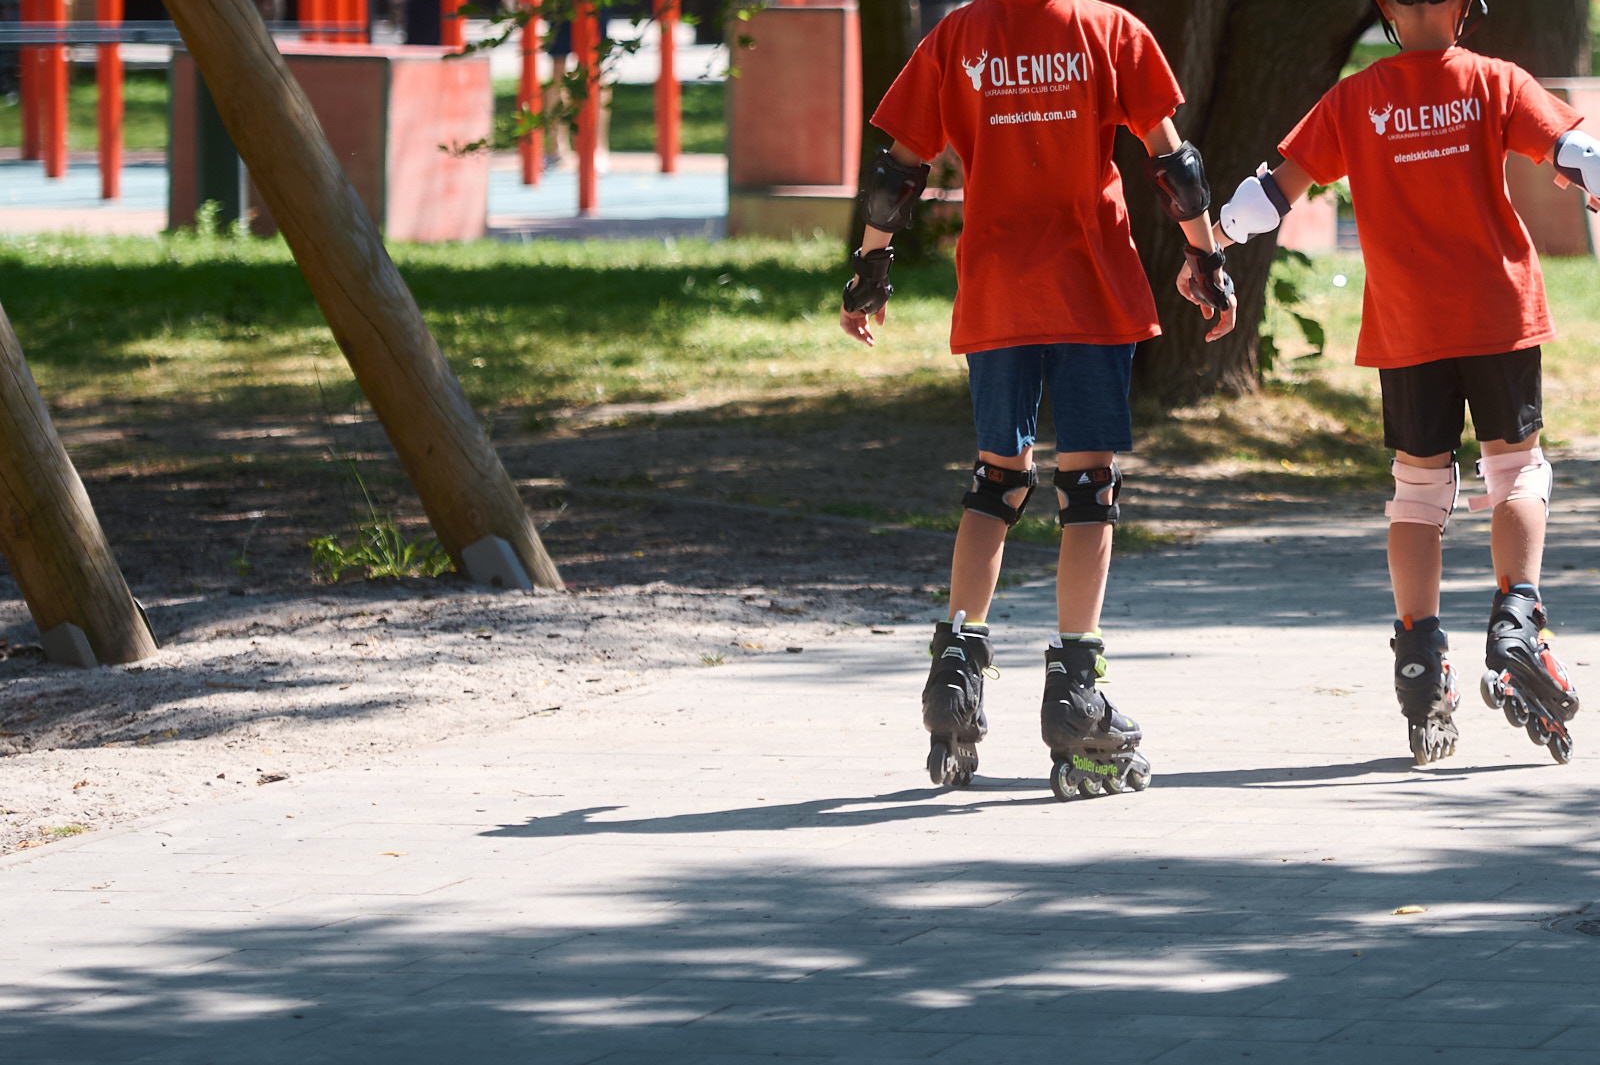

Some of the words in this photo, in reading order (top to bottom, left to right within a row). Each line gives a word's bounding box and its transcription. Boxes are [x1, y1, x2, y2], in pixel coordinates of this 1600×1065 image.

[990, 52, 1088, 86] OLENISKI
[985, 88, 1018, 98] UKRAINIAN
[1018, 87, 1030, 95] SKI
[1030, 85, 1049, 94] CLUB
[1049, 84, 1070, 93] OLENI
[990, 108, 1077, 125] oleniskiclub.com.ua
[1394, 98, 1480, 132] OLENISKI
[1387, 131, 1420, 141] UKRAINIAN
[1431, 128, 1448, 137] CLUB
[1448, 123, 1466, 133] OLENI
[1394, 144, 1469, 163] oleniskiclub.com.ua
